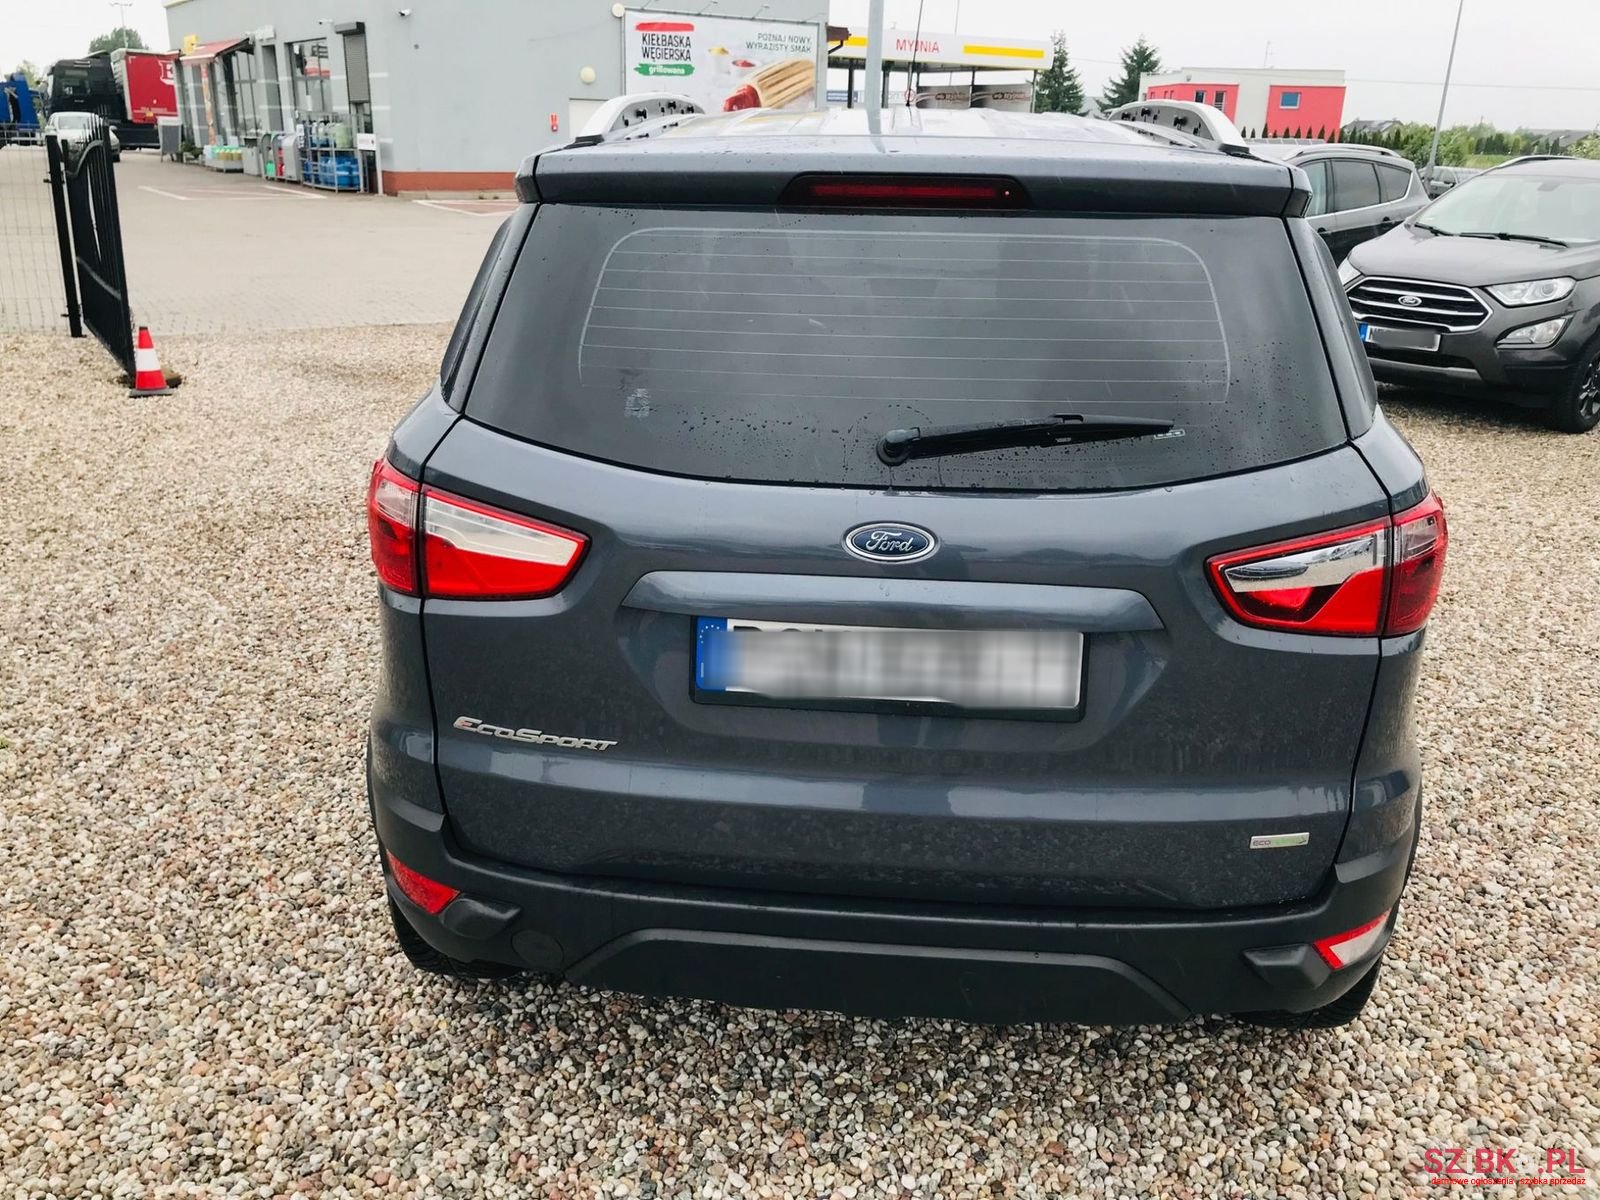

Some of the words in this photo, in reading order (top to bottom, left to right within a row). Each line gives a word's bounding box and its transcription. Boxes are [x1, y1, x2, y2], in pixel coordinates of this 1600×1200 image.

[641, 33, 692, 49] KIEŁBASKA
[757, 33, 786, 41] POZNAJ
[788, 34, 811, 43] NOWY
[641, 46, 692, 62] WĘGIERSKA
[745, 41, 788, 52] WYRAZISTY
[791, 44, 811, 53] SMAK
[865, 530, 914, 552] Ford
